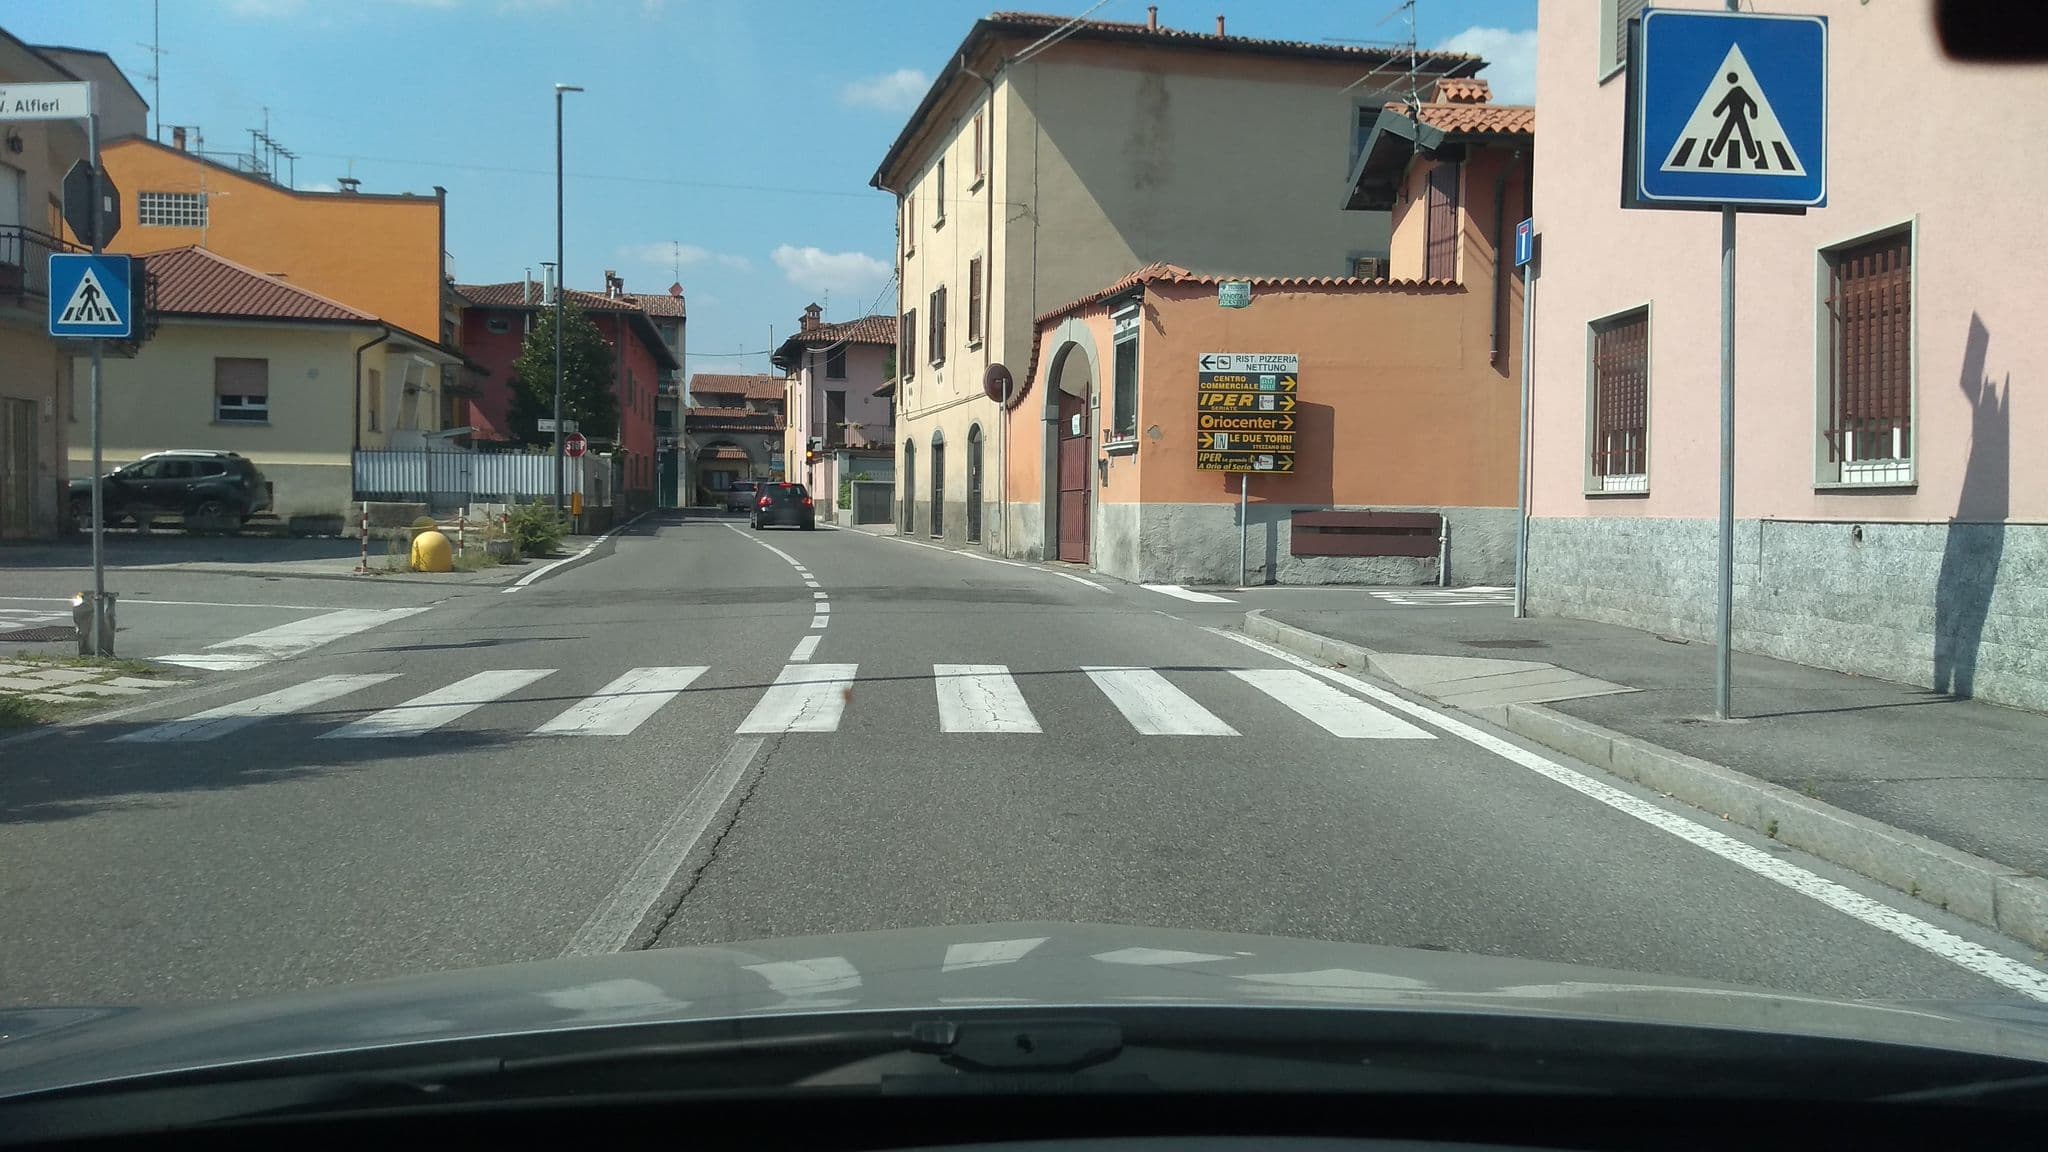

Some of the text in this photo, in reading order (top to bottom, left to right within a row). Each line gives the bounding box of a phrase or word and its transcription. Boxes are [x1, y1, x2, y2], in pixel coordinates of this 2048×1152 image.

[15, 99, 59, 112] Alfieri
[1235, 355, 1297, 363] RIST. PIZZERIA
[1200, 382, 1259, 390] COMMERCIALE
[1200, 394, 1254, 406] IPER
[1200, 415, 1278, 429] Oriocenter
[1229, 434, 1240, 443] LE
[1242, 434, 1262, 443] DUE
[1264, 434, 1292, 443] TORRI
[566, 440, 585, 450] STOP
[1200, 453, 1222, 462] IPER
